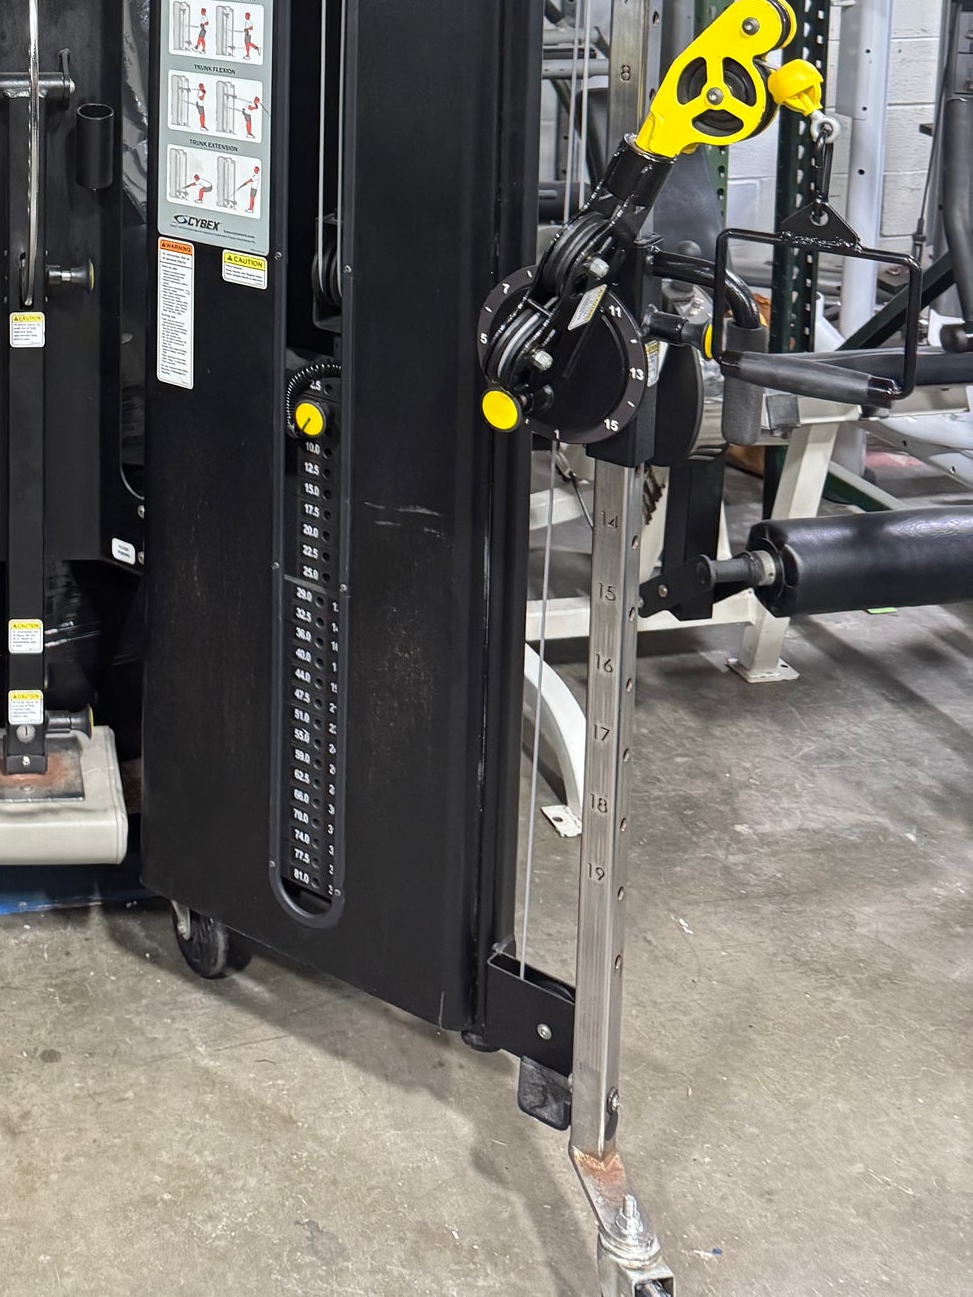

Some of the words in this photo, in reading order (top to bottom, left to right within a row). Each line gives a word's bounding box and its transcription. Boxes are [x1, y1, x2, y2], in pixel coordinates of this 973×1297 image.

[621, 65, 631, 81] 8
[188, 216, 220, 231] CYBEX
[234, 256, 262, 268] CAUTION
[503, 283, 509, 294] 7
[609, 305, 621, 318] 11
[480, 334, 487, 344] 5
[630, 367, 643, 381] 13
[604, 419, 619, 432] 15
[554, 429, 559, 439] 1
[305, 442, 320, 455] 10.0
[305, 462, 319, 476] 12.5
[305, 483, 319, 497] 15.0
[305, 504, 319, 518] 17.5
[601, 510, 618, 528] 14
[303, 524, 319, 538] 20.0
[303, 545, 319, 559] 22.5
[303, 566, 319, 580] 25.0
[297, 587, 312, 602] 29.0
[598, 582, 616, 601] 15
[296, 607, 311, 622] 32.5
[296, 648, 311, 663] 40.0
[596, 653, 613, 673] 16
[294, 688, 310, 704] 47.5
[295, 708, 310, 724] 51.0
[593, 724, 610, 741] 17
[294, 769, 310, 784] 62.5
[591, 793, 607, 814] 18
[294, 829, 310, 844] 74.0
[294, 848, 310, 864] 77.5
[294, 868, 309, 884] 81.0
[588, 863, 605, 881] 19
